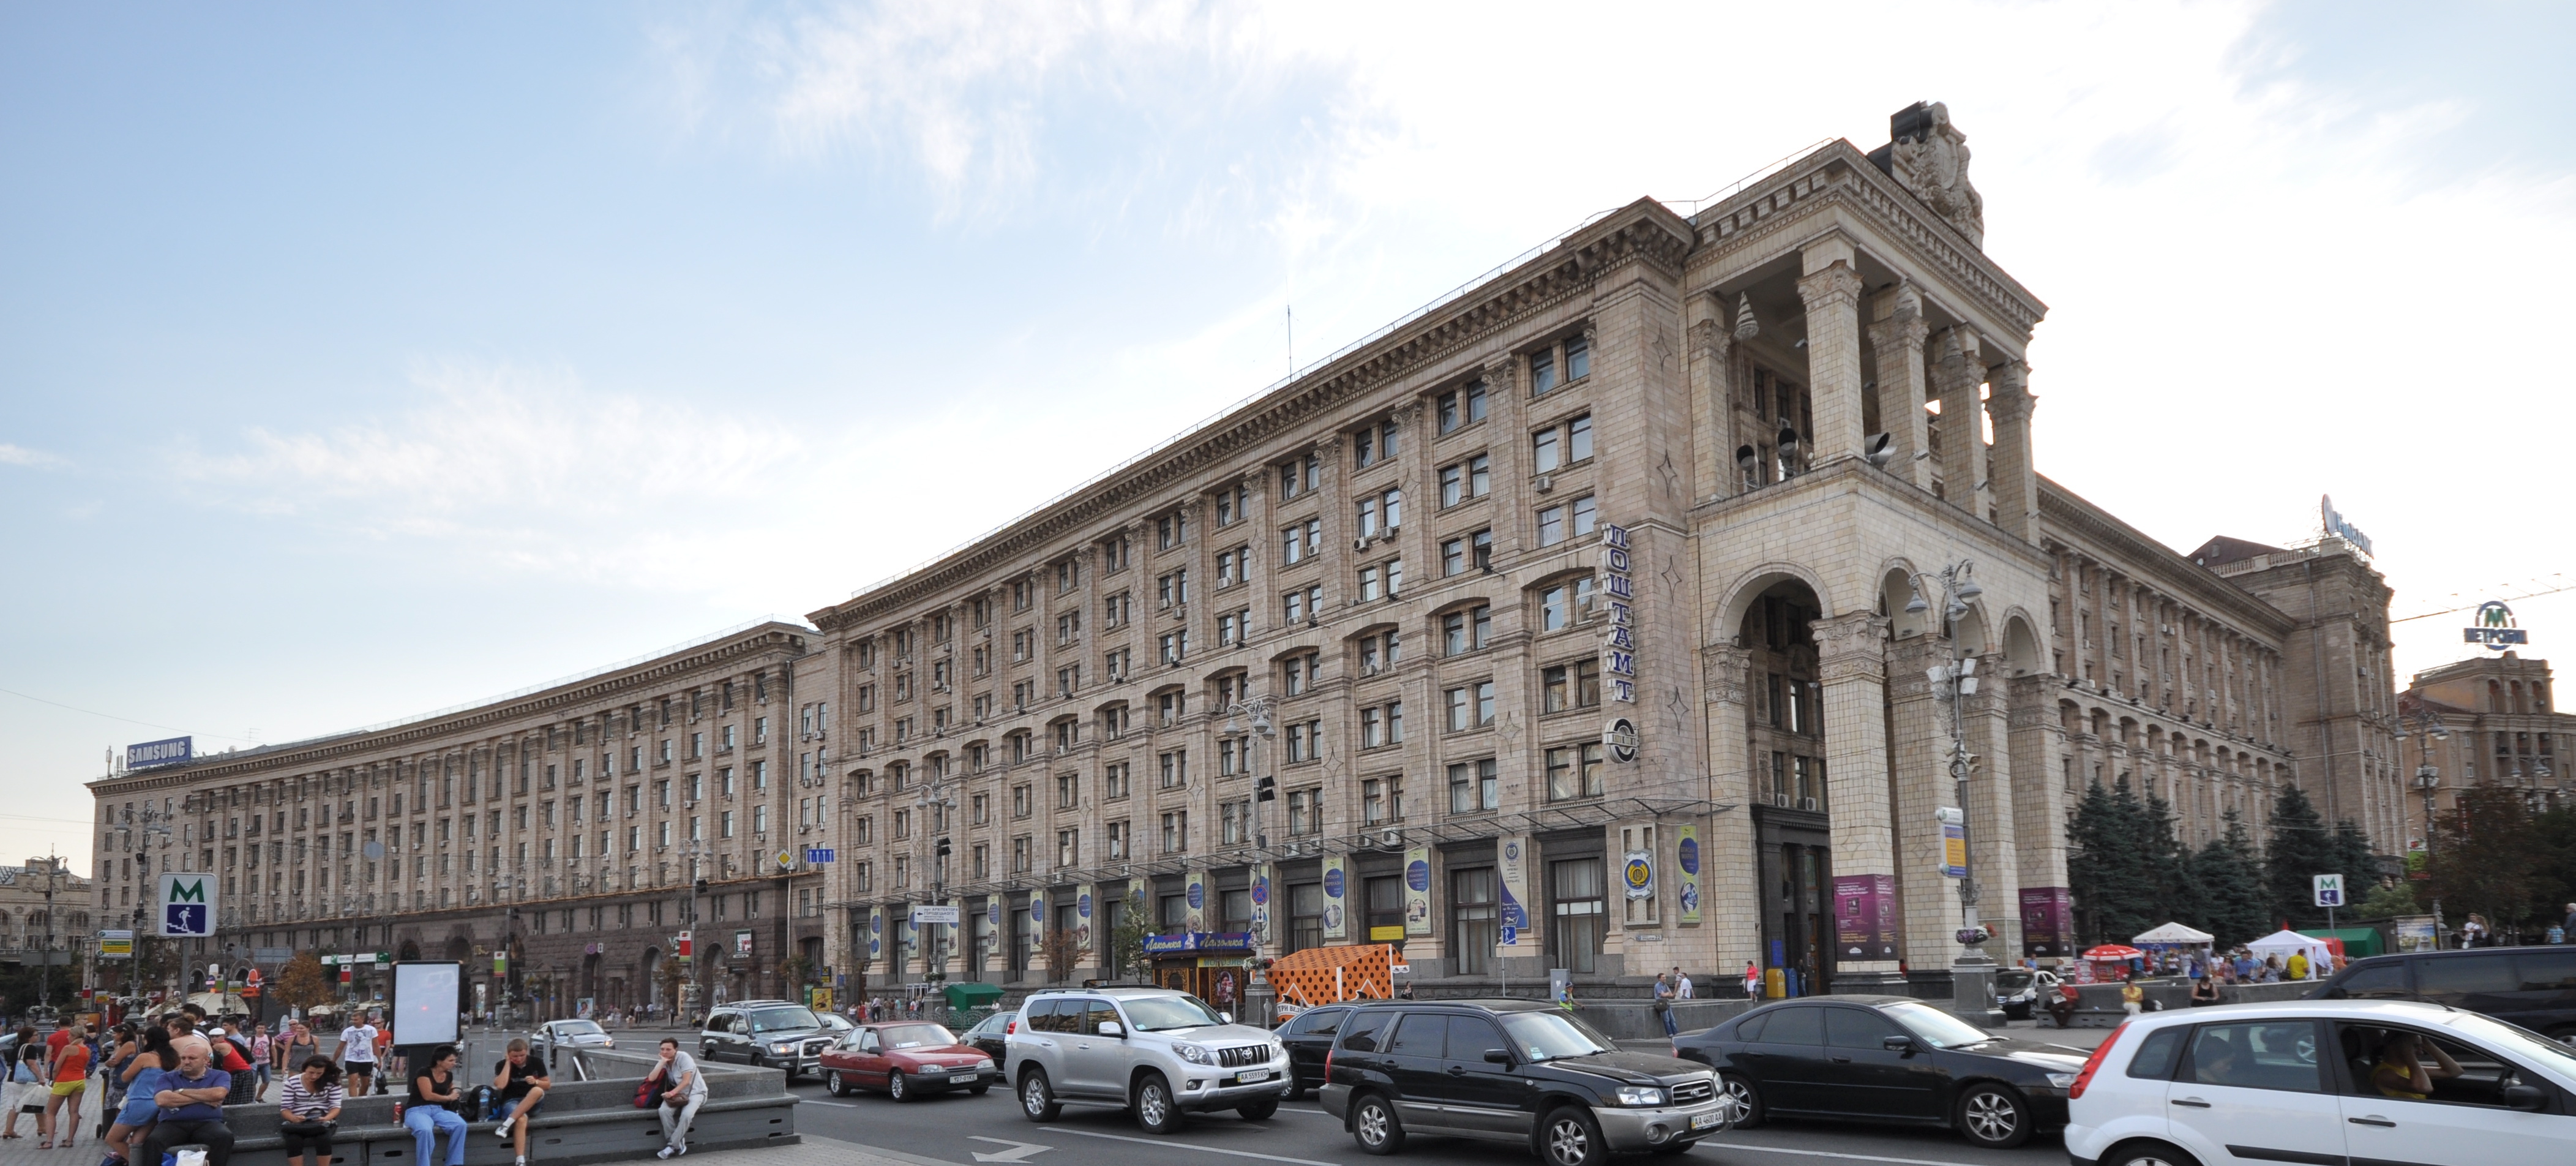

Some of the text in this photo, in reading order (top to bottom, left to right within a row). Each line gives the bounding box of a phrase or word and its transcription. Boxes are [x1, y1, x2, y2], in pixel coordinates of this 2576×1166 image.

[1608, 522, 1635, 702] ПОШТАМТ
[128, 740, 186, 764] SAMSUNG
[169, 877, 204, 903] М
[2320, 877, 2337, 889] М
[1145, 938, 1182, 950] Лакомка
